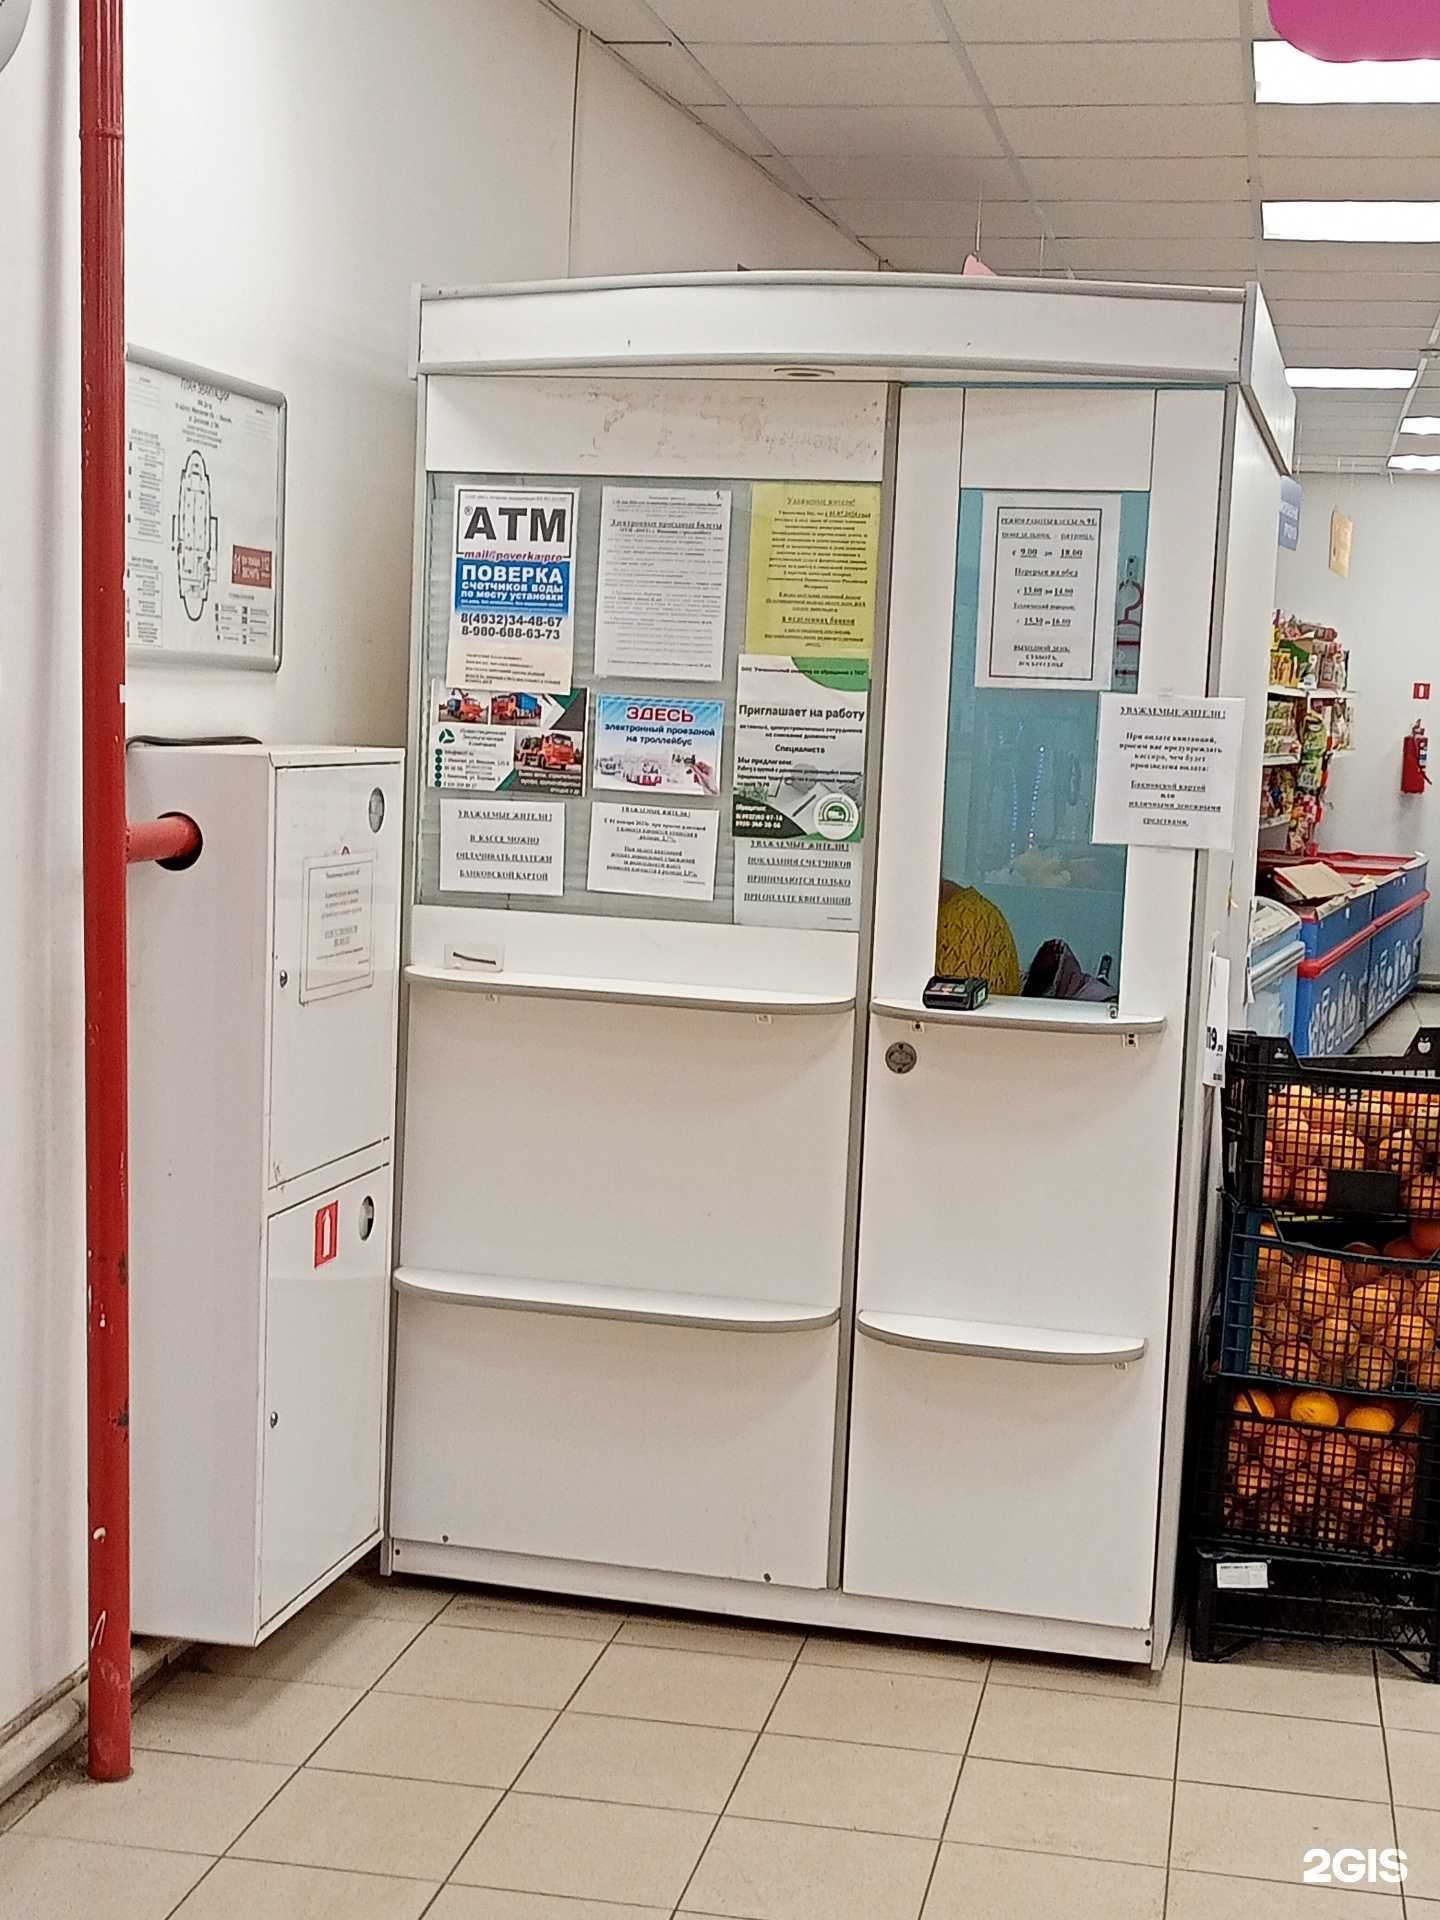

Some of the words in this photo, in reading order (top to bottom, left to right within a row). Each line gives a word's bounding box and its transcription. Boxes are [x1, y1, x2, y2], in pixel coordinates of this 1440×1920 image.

[464, 507, 566, 542] АТМ
[462, 565, 563, 583] ПОВЕРКА
[626, 706, 694, 723] ЗДЕСЬ
[739, 704, 807, 718] Приглашает
[809, 708, 823, 718] на
[825, 707, 865, 721] работу
[1120, 706, 1180, 718] УВАЖАЕМЫЕ
[666, 727, 715, 737] проездной
[1126, 732, 1142, 740] При
[640, 737, 693, 746] троллейбус
[1119, 743, 1148, 751] просим
[1185, 754, 1206, 763] будет
